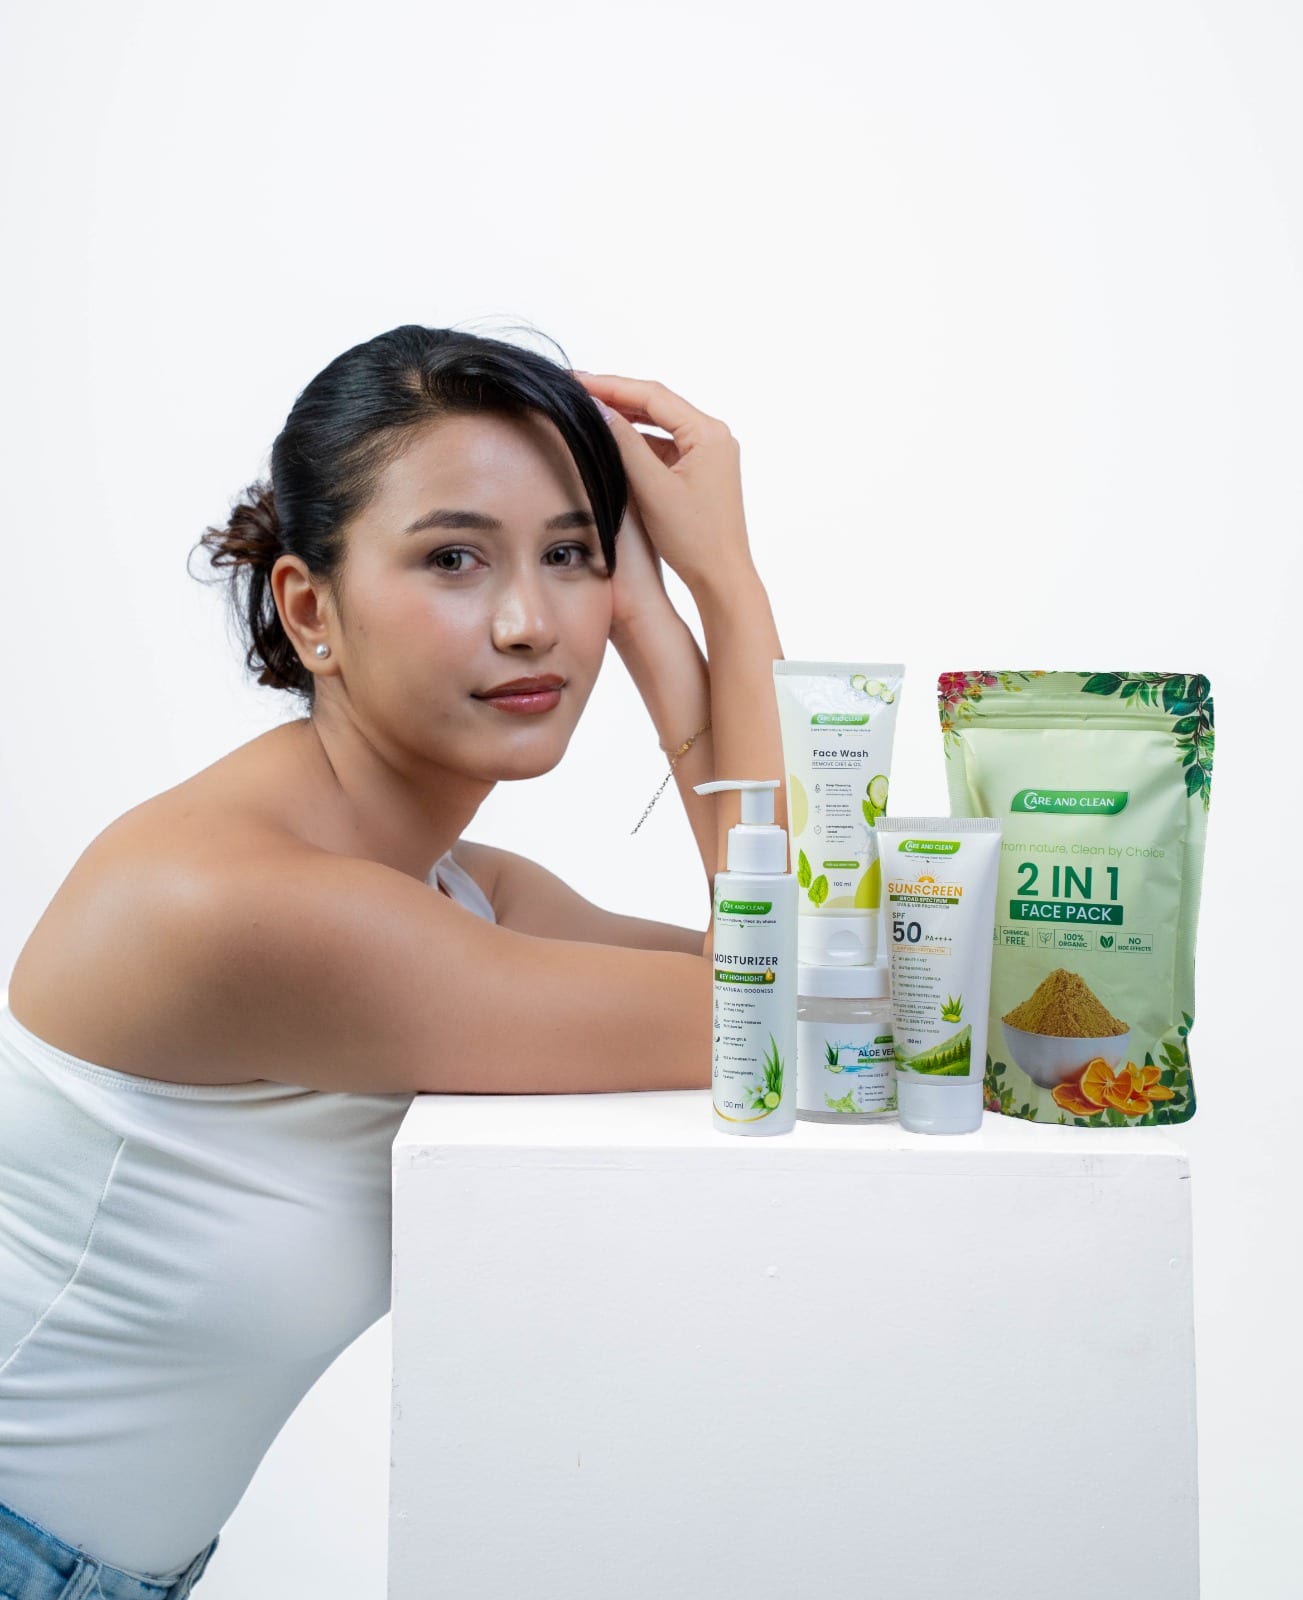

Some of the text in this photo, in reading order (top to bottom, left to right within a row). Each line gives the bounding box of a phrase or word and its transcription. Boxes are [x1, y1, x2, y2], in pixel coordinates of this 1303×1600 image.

[813, 749, 869, 757] Face Wash
[1023, 792, 1115, 810] CARE AND CLEAN
[1001, 841, 1166, 858] from nature, Clean by Choice
[1017, 862, 1119, 901] 2 IN 1
[888, 883, 963, 897] SUNSCREEN
[1021, 903, 1113, 922] FACE PACK
[892, 921, 922, 943] 50
[1002, 929, 1030, 937] CHEMICAL
[1063, 933, 1084, 941] 100%
[1005, 936, 1026, 946] FREE
[1058, 940, 1088, 948] ORGANIC
[1128, 937, 1142, 945] NO
[729, 974, 763, 982] HIGHLIGHT
[858, 1047, 896, 1057] ALOE VER
